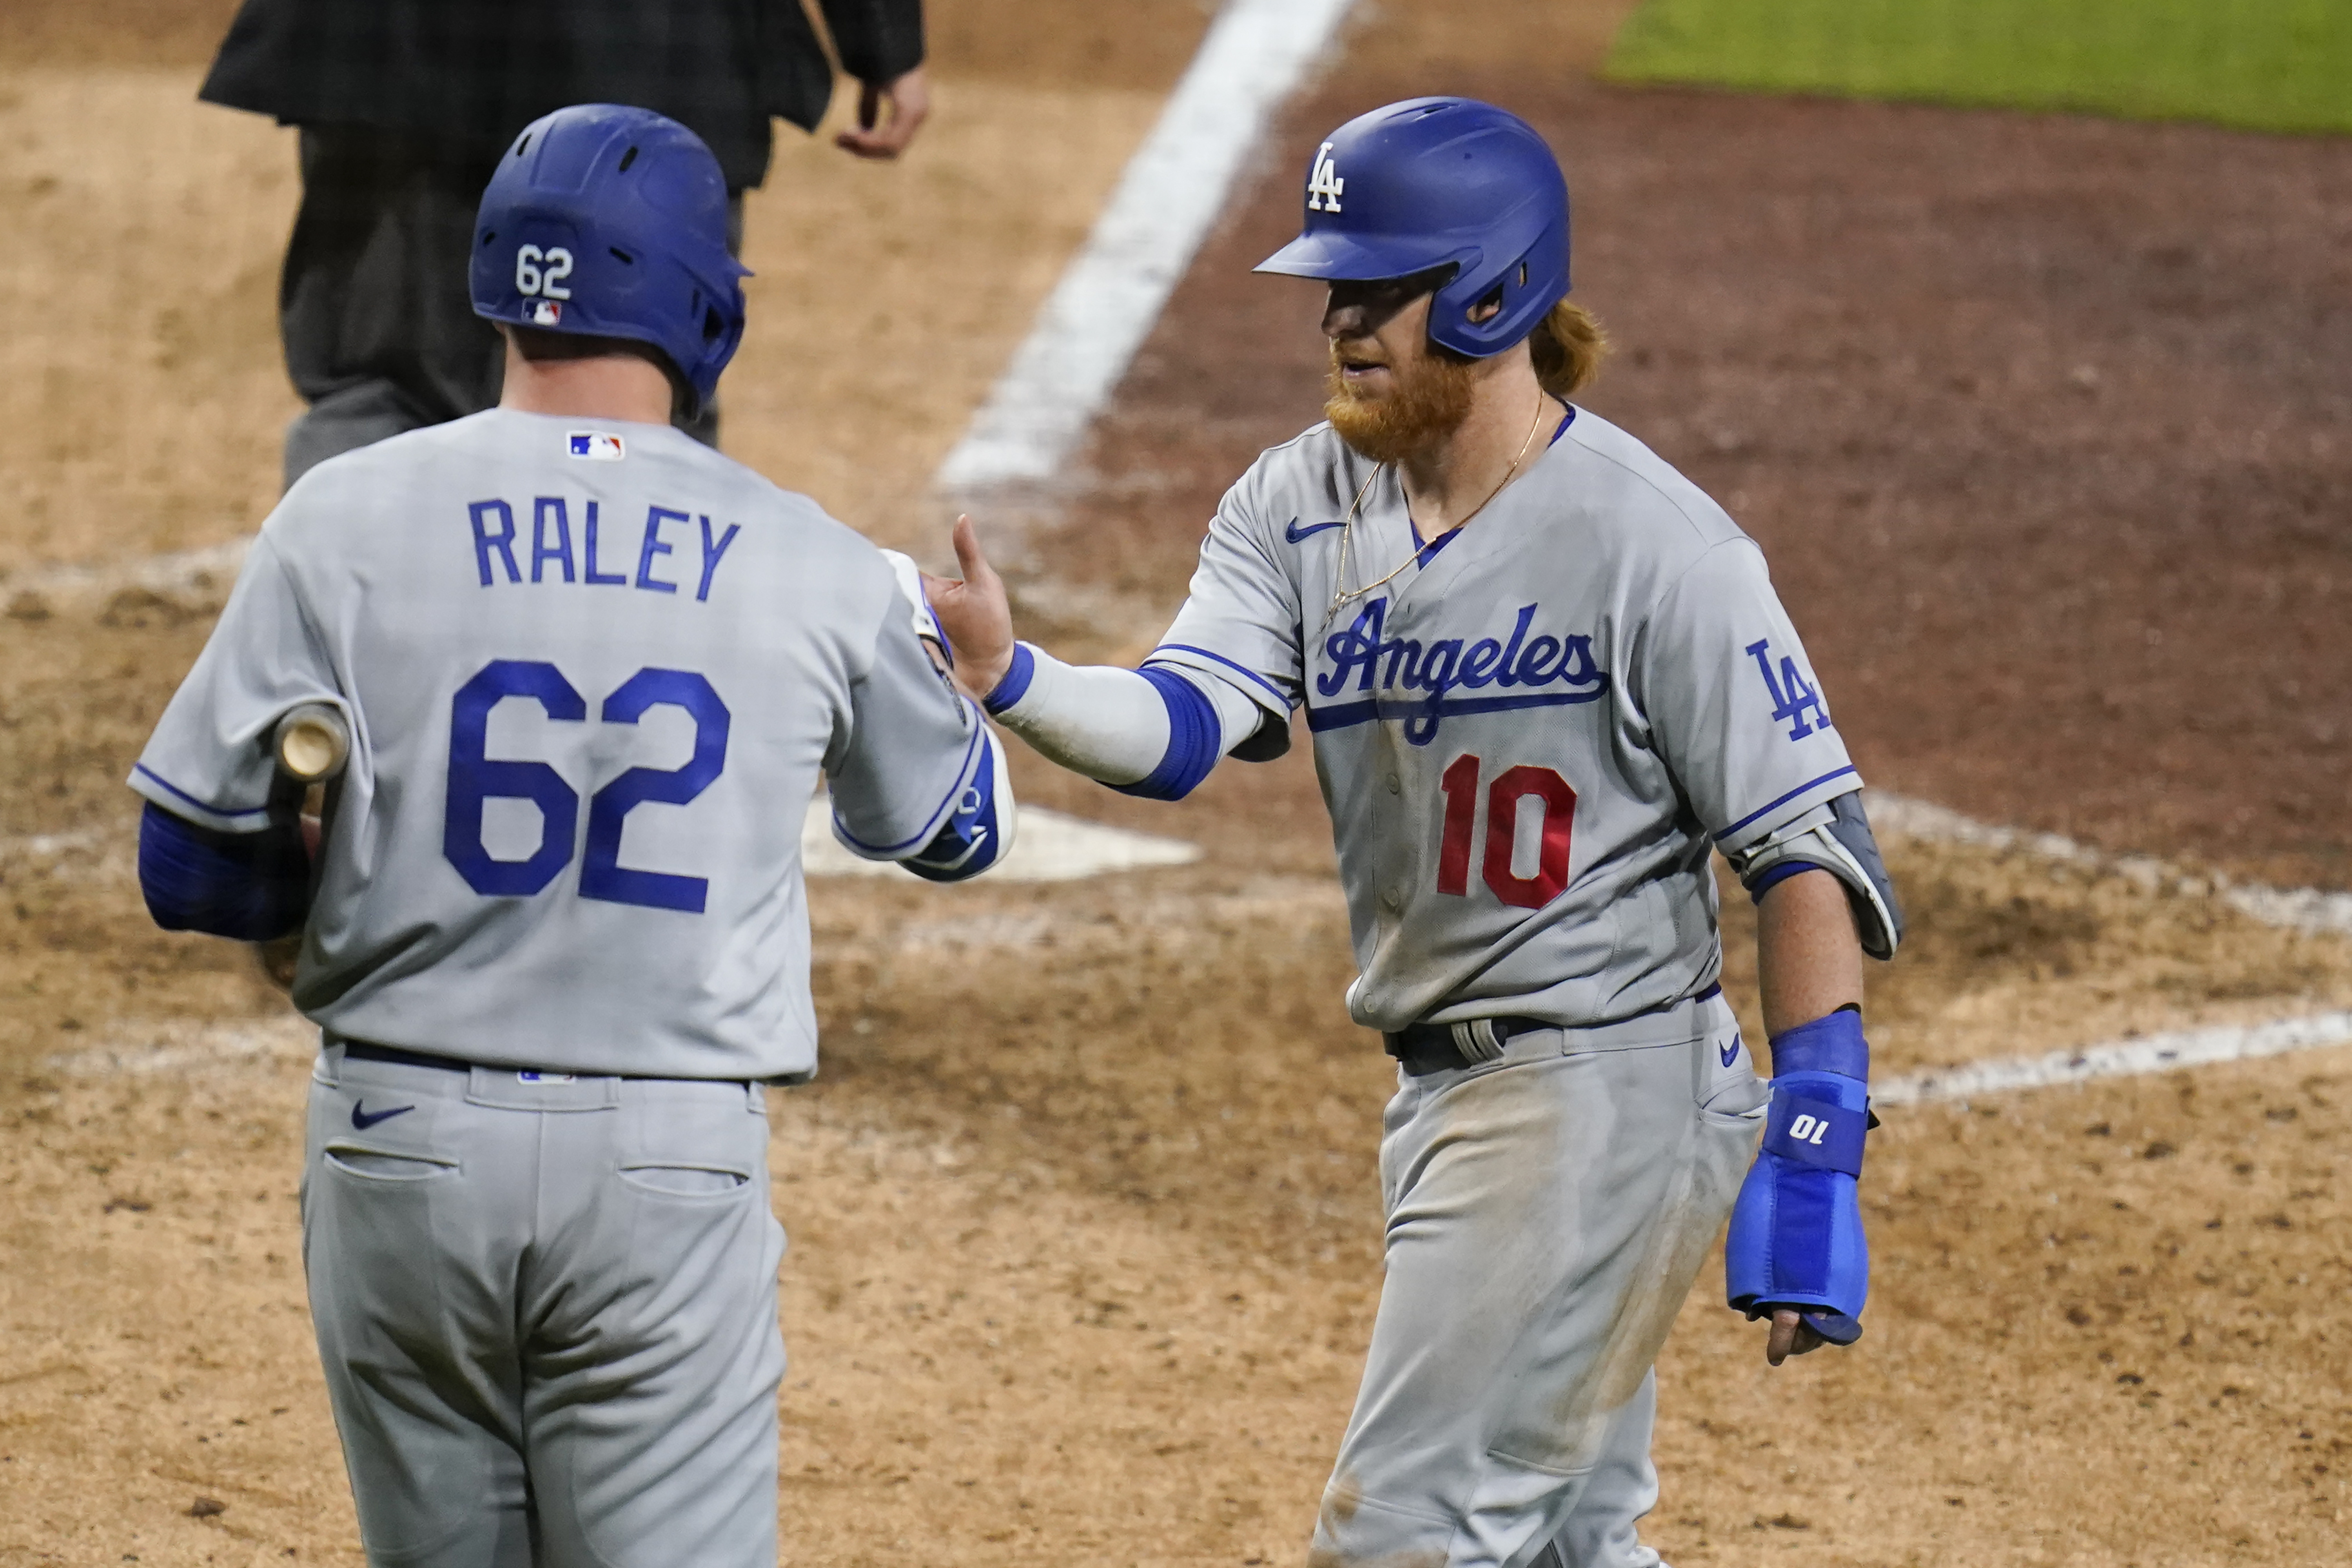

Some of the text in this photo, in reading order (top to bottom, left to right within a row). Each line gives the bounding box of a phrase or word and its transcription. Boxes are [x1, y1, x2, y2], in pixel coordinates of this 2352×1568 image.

[1308, 142, 1344, 213] LA
[515, 244, 573, 299] 62
[468, 496, 741, 602] RALEY
[1318, 597, 1610, 746] Angeles
[1746, 638, 1831, 742] LA
[443, 659, 731, 913] 62
[1437, 753, 1577, 909] 10
[1789, 1114, 1829, 1145] 10
